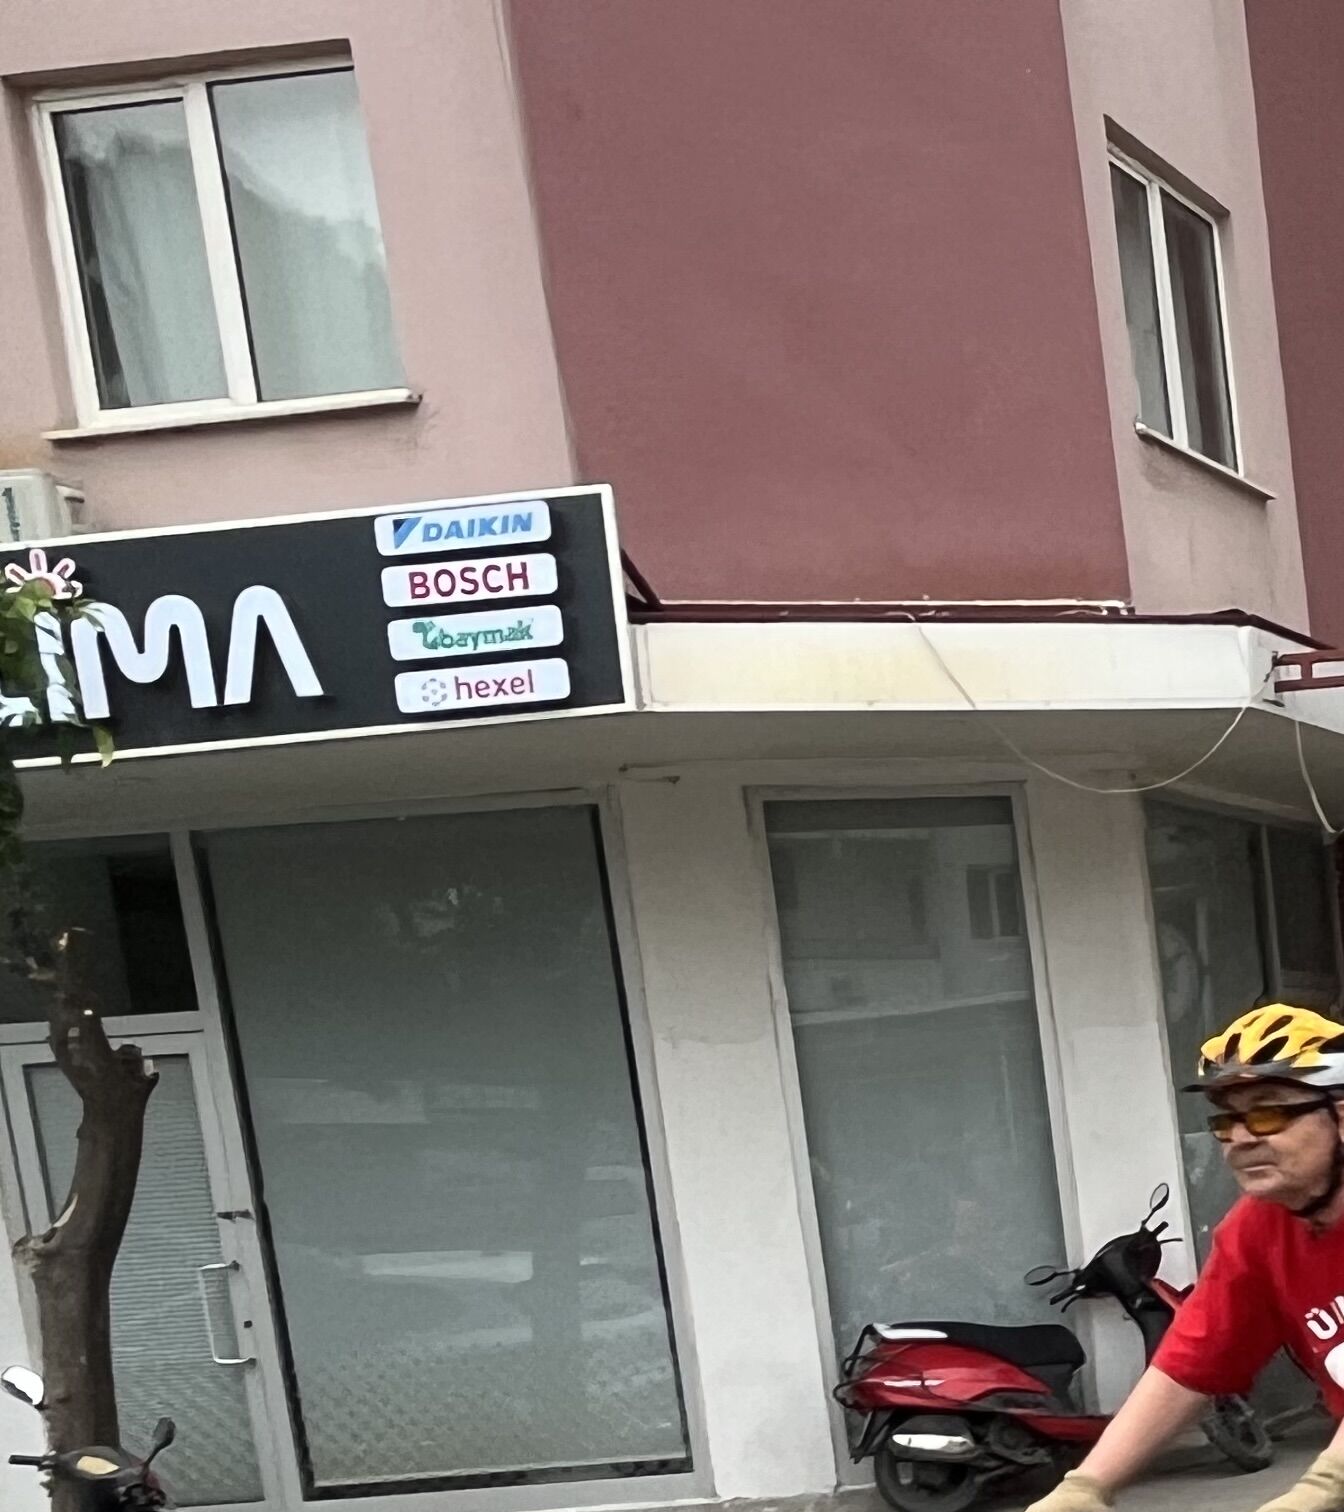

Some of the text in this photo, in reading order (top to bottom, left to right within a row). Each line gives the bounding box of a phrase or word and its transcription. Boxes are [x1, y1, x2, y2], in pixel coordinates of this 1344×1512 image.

[421, 511, 533, 543] DAIKIN
[408, 561, 530, 600] BOSCH
[453, 668, 535, 701] hexel
